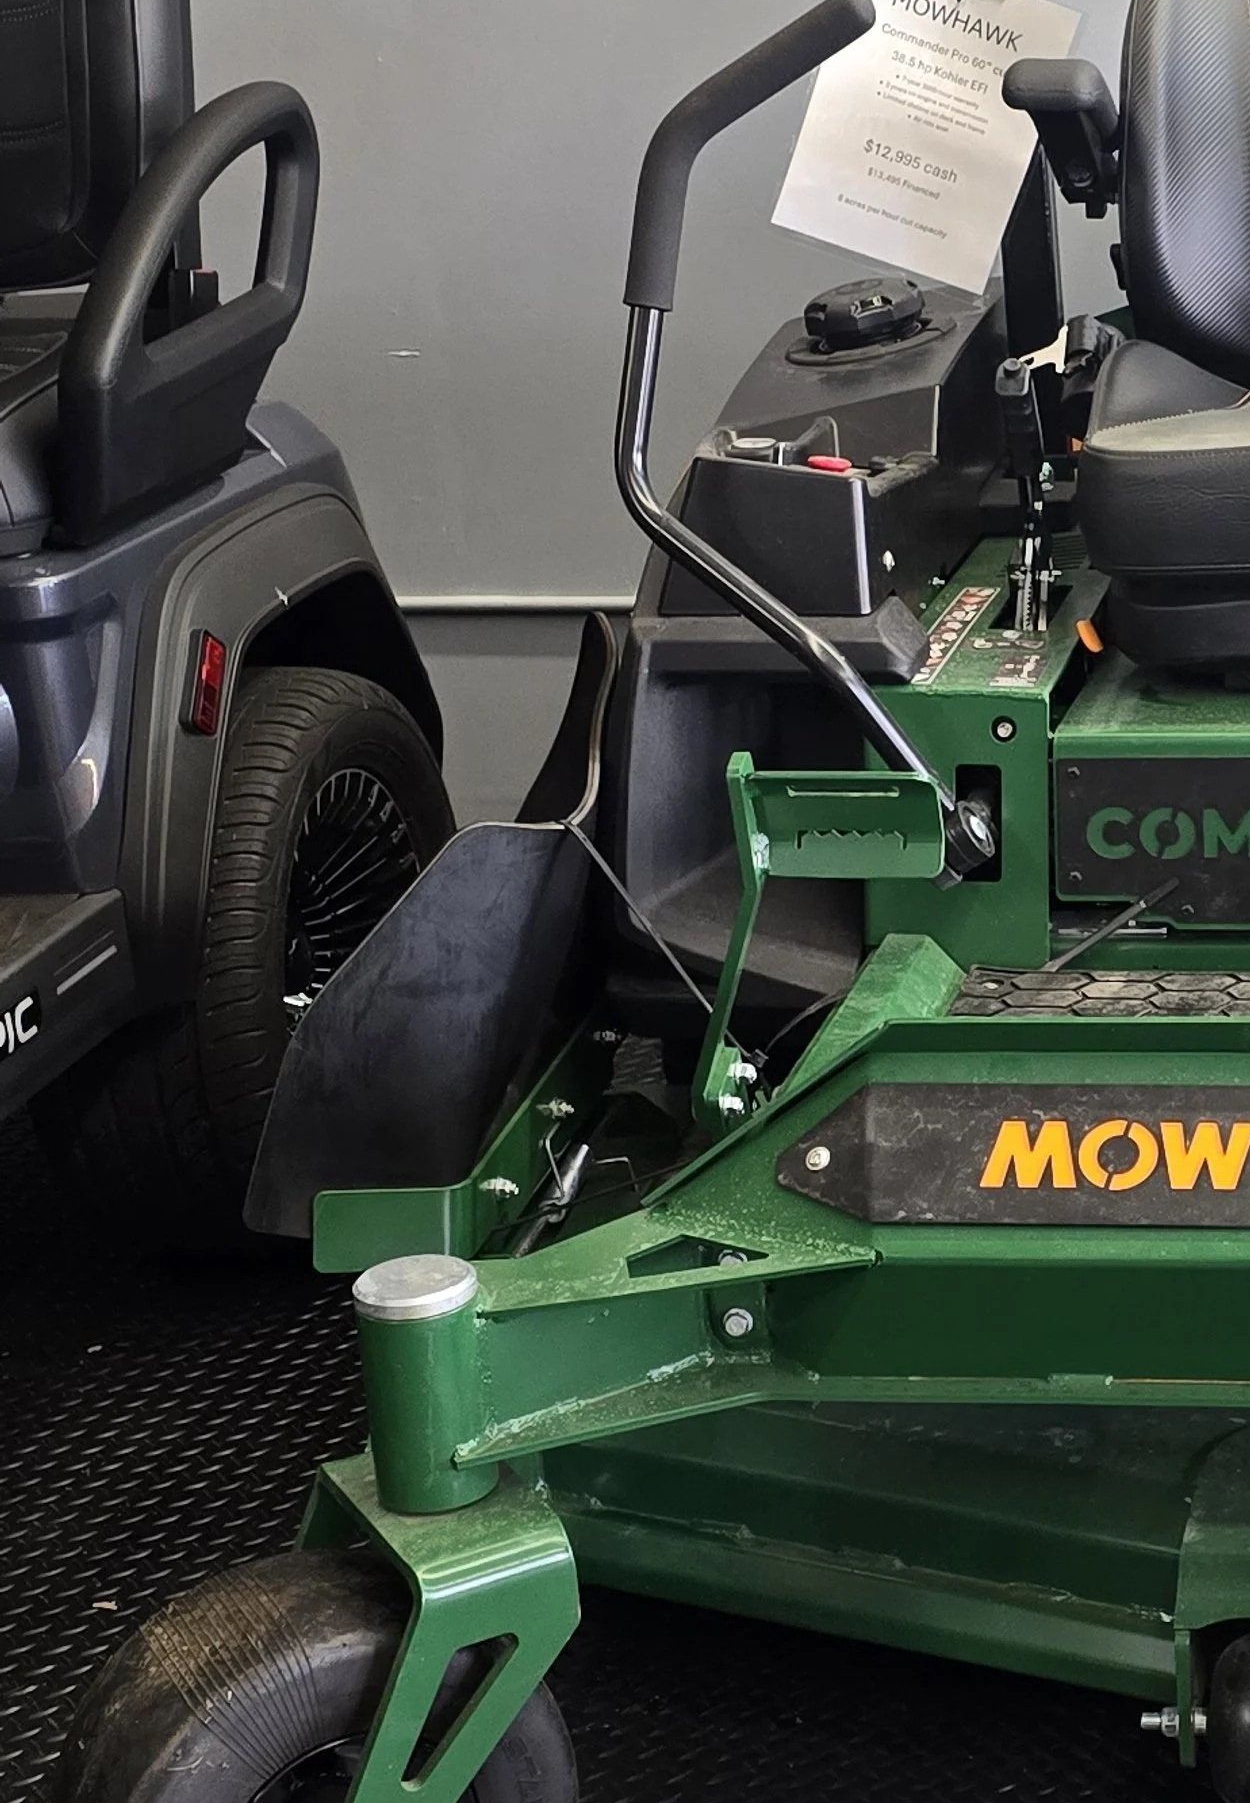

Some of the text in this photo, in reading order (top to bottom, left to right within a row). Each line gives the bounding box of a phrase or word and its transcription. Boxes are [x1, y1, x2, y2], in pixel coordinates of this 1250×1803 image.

[882, 24, 949, 56] Commander
[951, 48, 969, 64] Pro
[892, 51, 988, 94] 38.5 hp Kohler EFI
[864, 139, 957, 183] $12,995 cash
